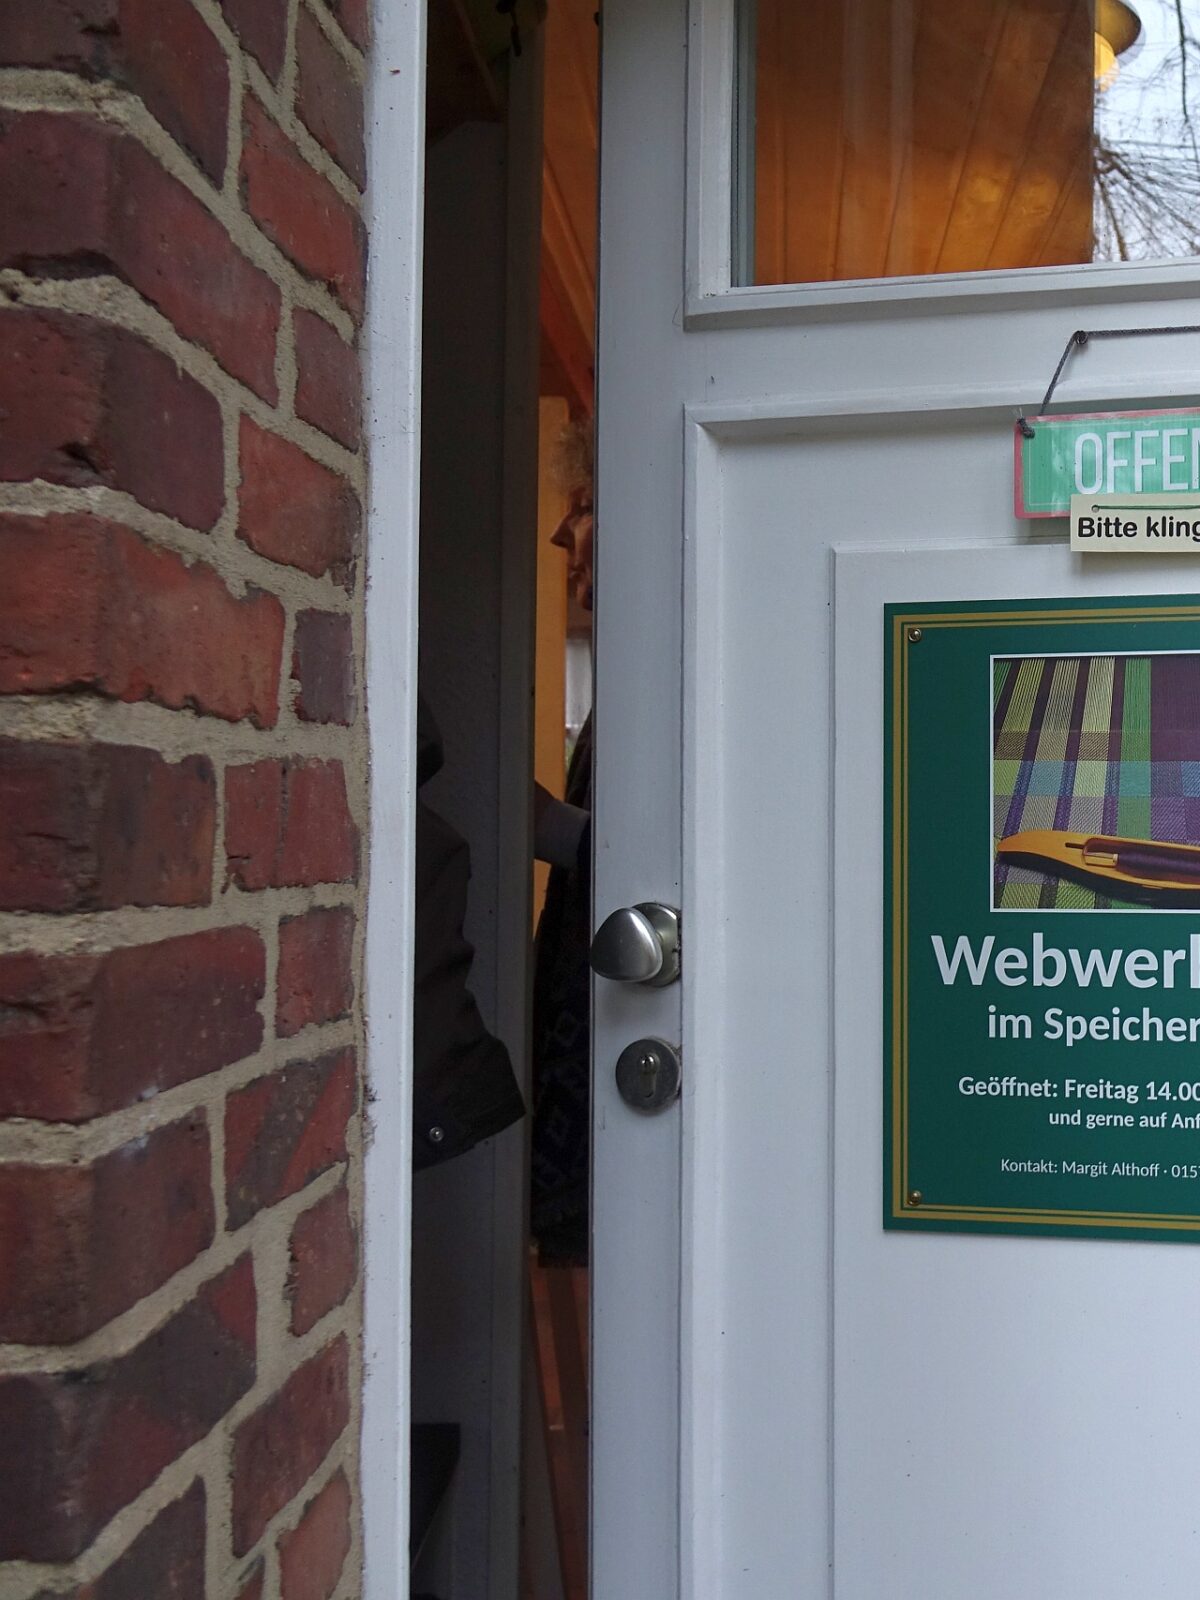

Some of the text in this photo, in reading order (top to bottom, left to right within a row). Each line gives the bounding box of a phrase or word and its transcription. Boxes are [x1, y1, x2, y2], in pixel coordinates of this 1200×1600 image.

[1077, 516, 1138, 538] Bitte
[988, 1004, 1032, 1039] im
[958, 1076, 1058, 1099] Geöffnet:
[1064, 1078, 1139, 1105] Freitag
[1049, 1109, 1081, 1127] und
[1085, 1113, 1135, 1130] gerne
[1139, 1111, 1168, 1129] auf
[1001, 1158, 1058, 1175] Kontakt:
[1062, 1160, 1108, 1178] Margit
[1112, 1161, 1160, 1178] Althoff
